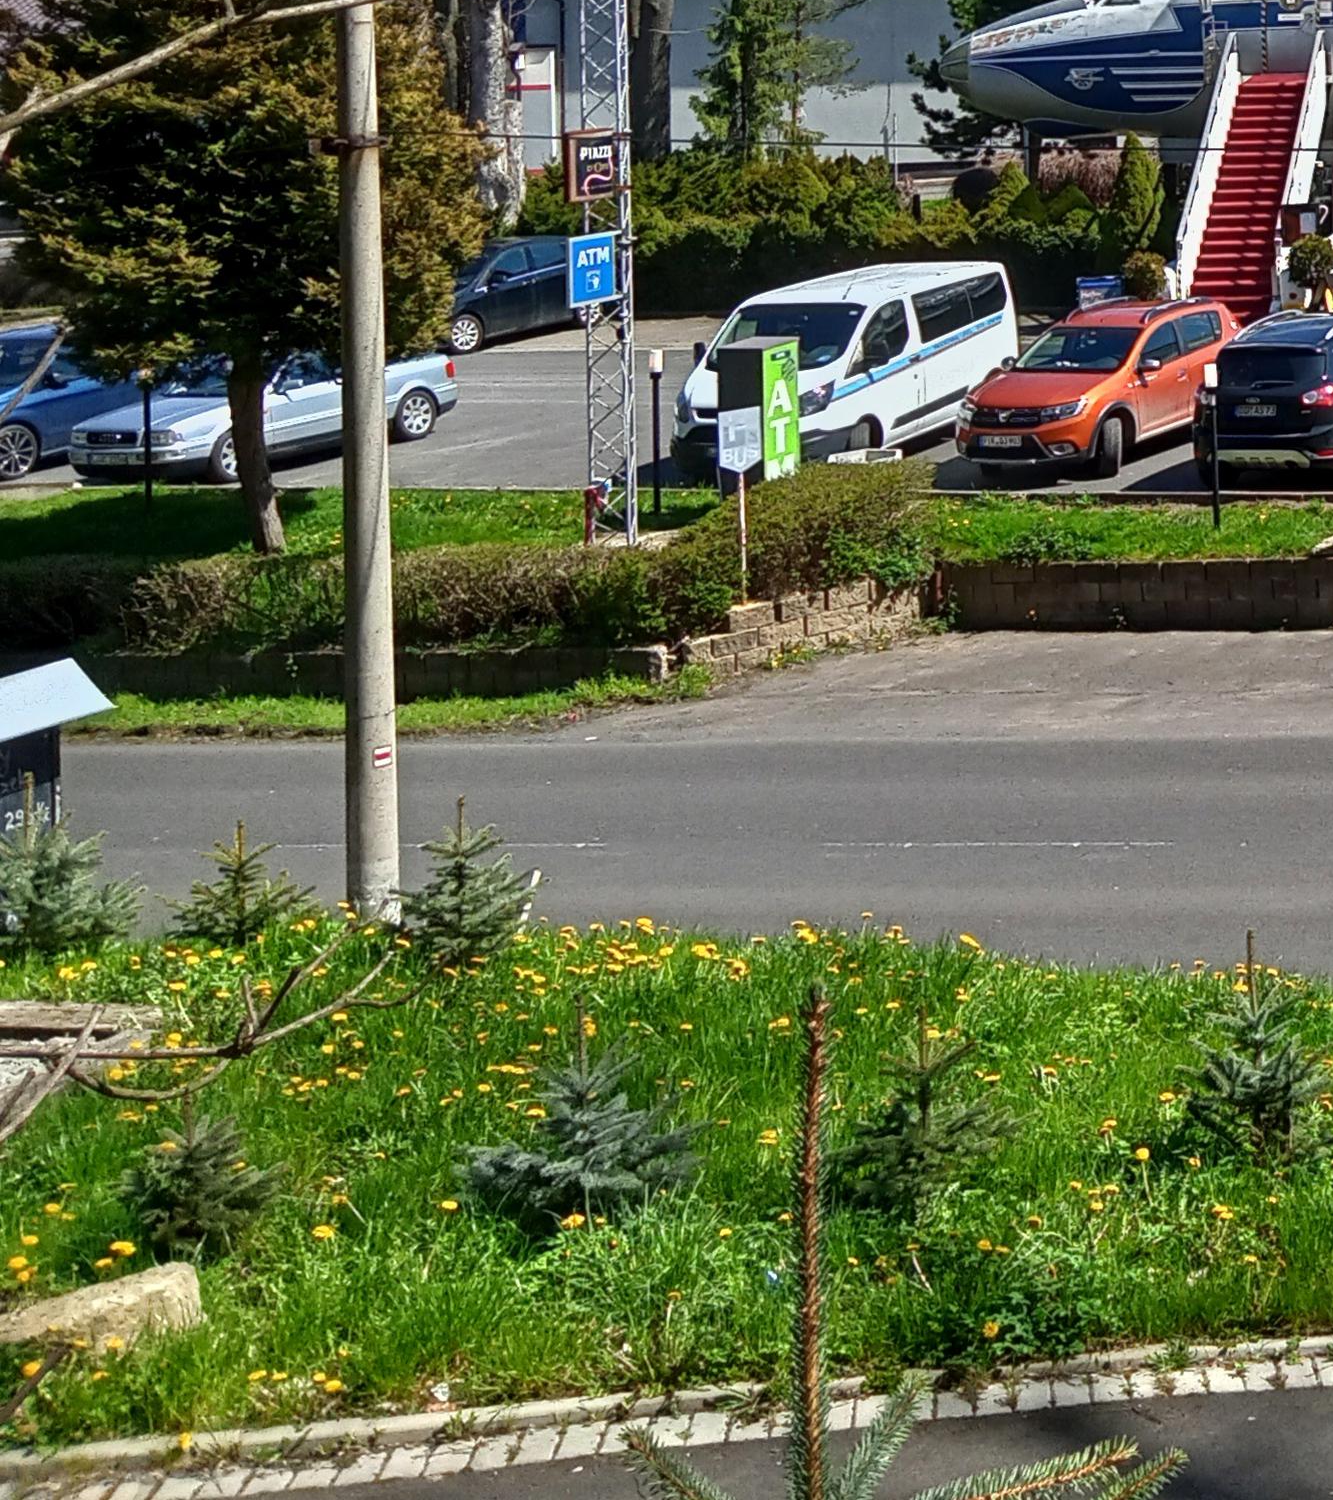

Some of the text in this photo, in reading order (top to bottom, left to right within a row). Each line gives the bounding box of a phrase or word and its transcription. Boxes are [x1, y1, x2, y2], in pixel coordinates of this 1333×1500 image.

[580, 145, 613, 161] PIAZZ
[577, 246, 610, 268] ATM
[766, 379, 795, 481] ATM
[723, 449, 758, 468] BUS
